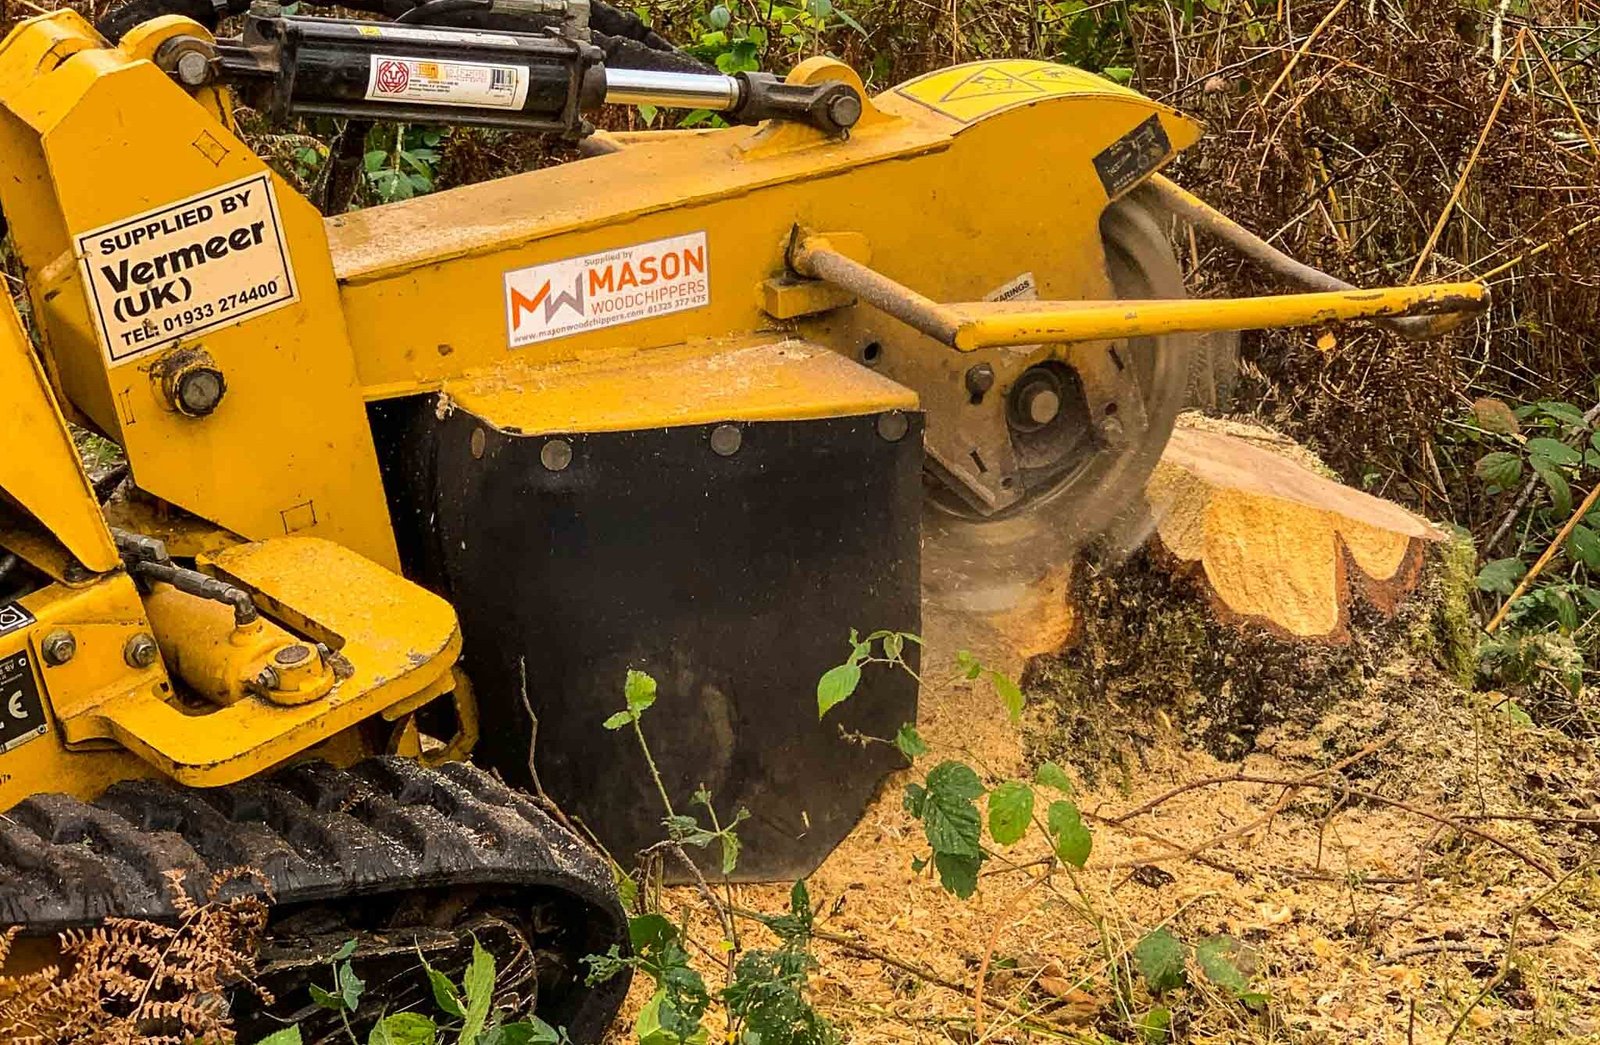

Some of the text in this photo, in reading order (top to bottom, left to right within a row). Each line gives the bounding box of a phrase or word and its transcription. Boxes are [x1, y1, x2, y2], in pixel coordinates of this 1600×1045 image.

[100, 189, 251, 255] SUPPLIED BY
[100, 220, 265, 294] Vermeer
[584, 250, 634, 266] Supplied by
[589, 246, 704, 297] MASON
[113, 277, 192, 323] (UK)
[121, 280, 278, 347] TEL: 01933 274400
[590, 279, 705, 315] WOODCHIPPERS
[513, 308, 644, 343] www.masonwoodchippers.com
